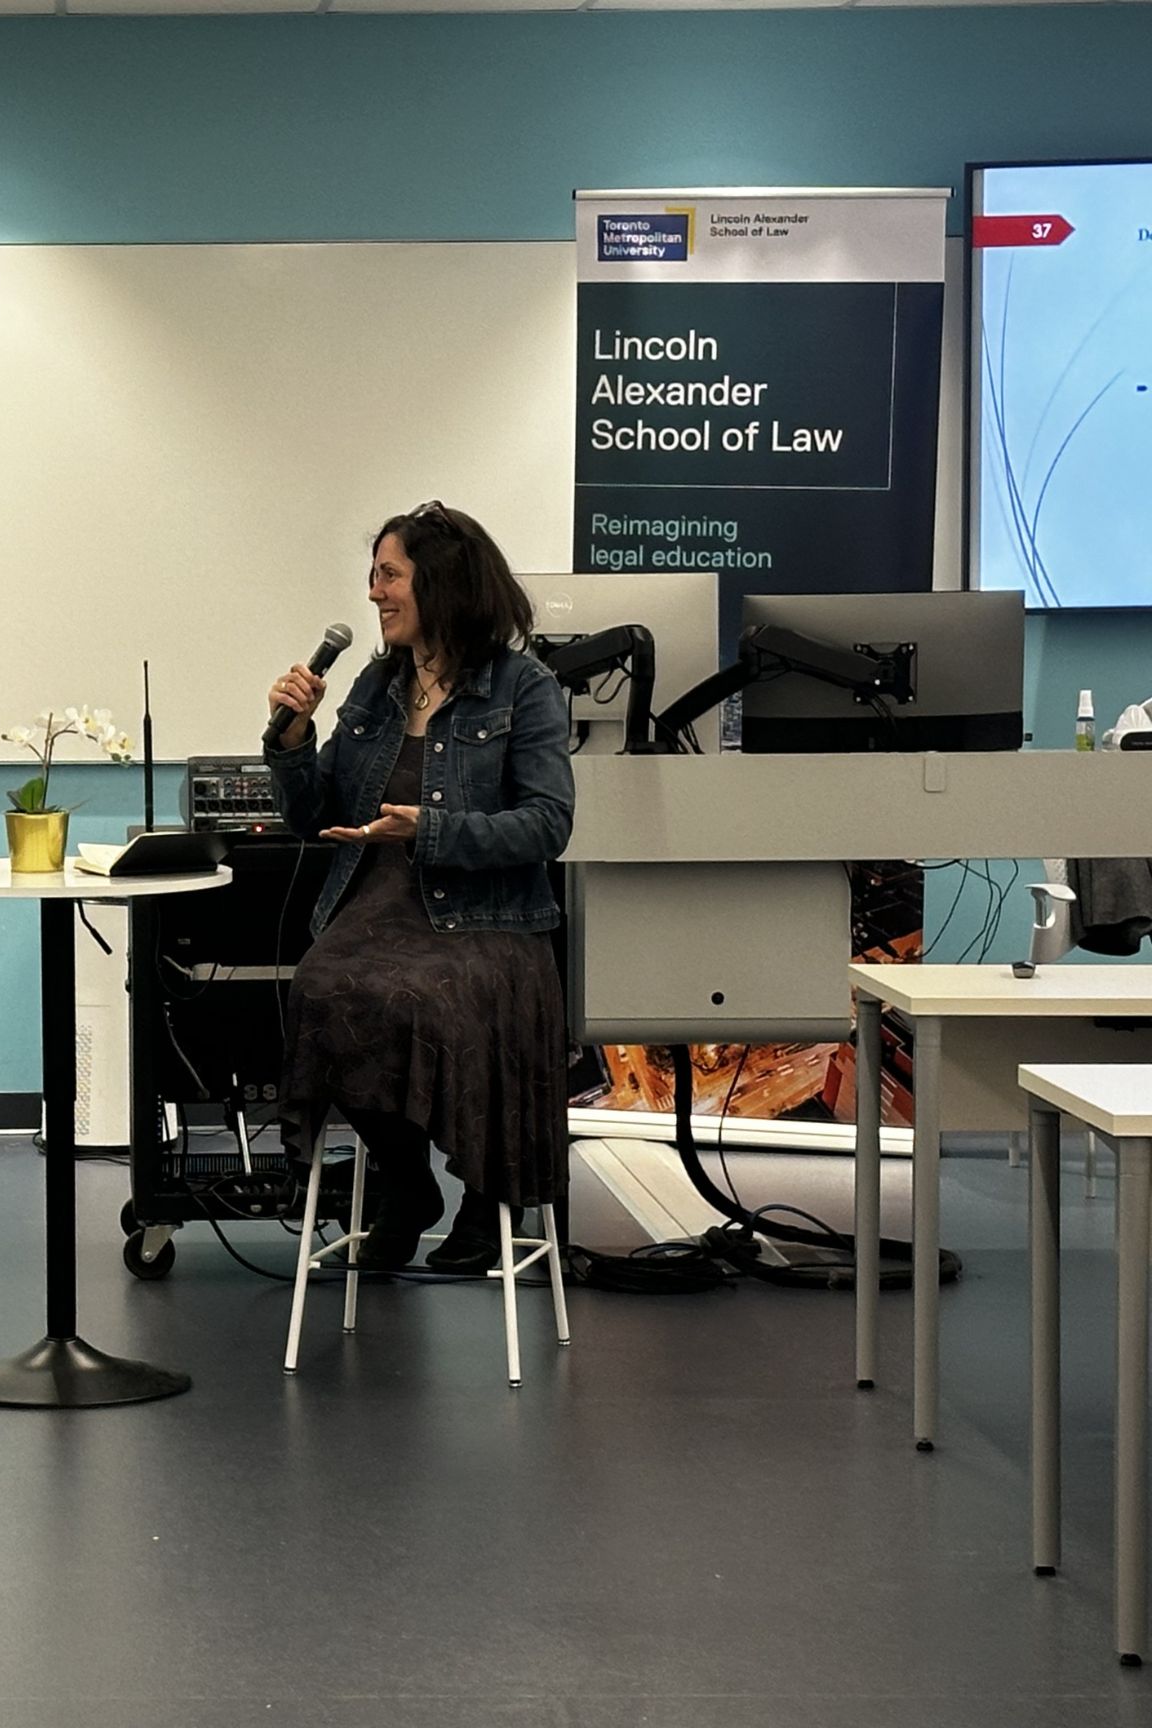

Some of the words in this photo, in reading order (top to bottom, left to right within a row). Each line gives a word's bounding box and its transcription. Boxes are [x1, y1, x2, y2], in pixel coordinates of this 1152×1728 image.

[603, 219, 651, 231] Toronto
[710, 213, 751, 225] Lincoln
[753, 213, 810, 225] Alexander
[603, 232, 683, 246] Metropolitan
[710, 226, 748, 237] School
[750, 226, 764, 237] of
[766, 226, 789, 237] Law
[1031, 223, 1052, 239] 37
[603, 245, 666, 258] University
[594, 329, 718, 361] Lincoln
[591, 374, 768, 406] Alexander
[591, 419, 710, 451] School
[722, 421, 760, 451] of
[772, 421, 843, 452] Law
[591, 513, 738, 543] Reimagining
[590, 544, 644, 571] legal
[651, 545, 773, 568] education
